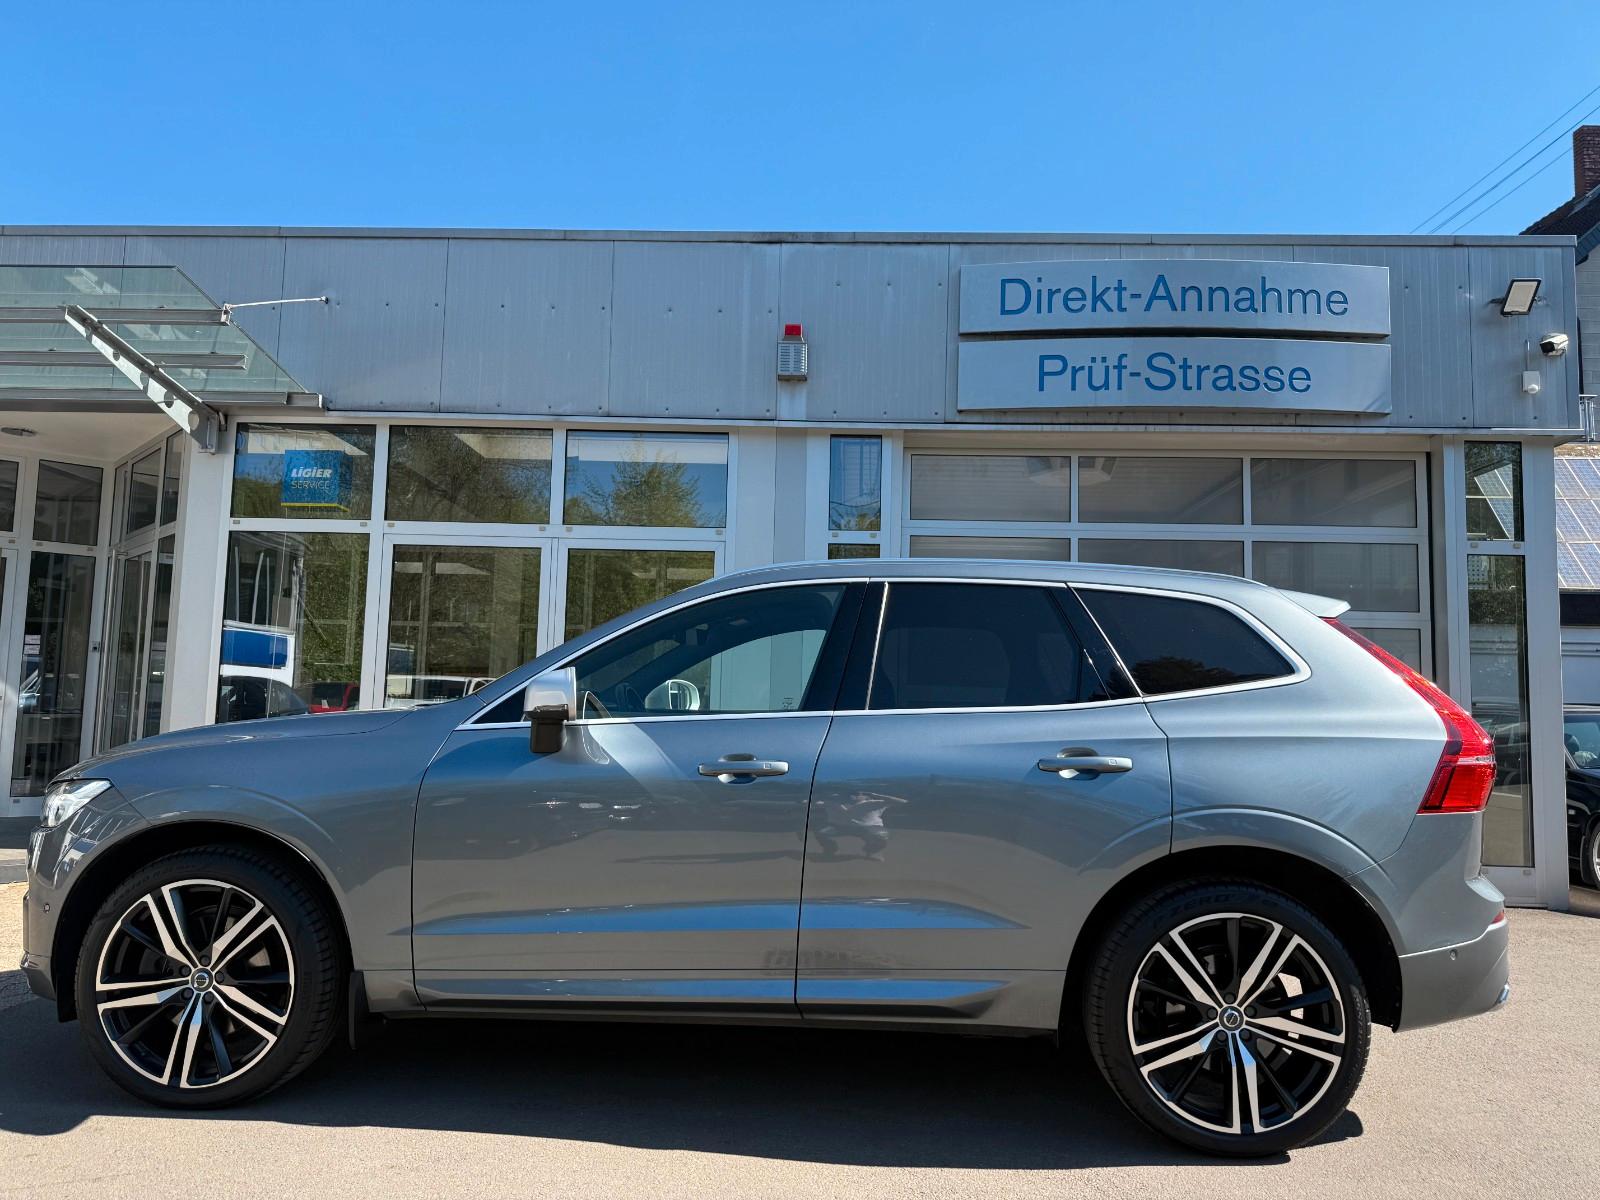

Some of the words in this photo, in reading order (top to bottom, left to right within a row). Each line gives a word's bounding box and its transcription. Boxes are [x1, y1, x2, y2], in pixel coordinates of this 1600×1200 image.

[1000, 274, 1349, 317] Direkt-Annahme
[1037, 351, 1312, 393] Prüf-Strasse
[290, 480, 331, 490] SERVICE
